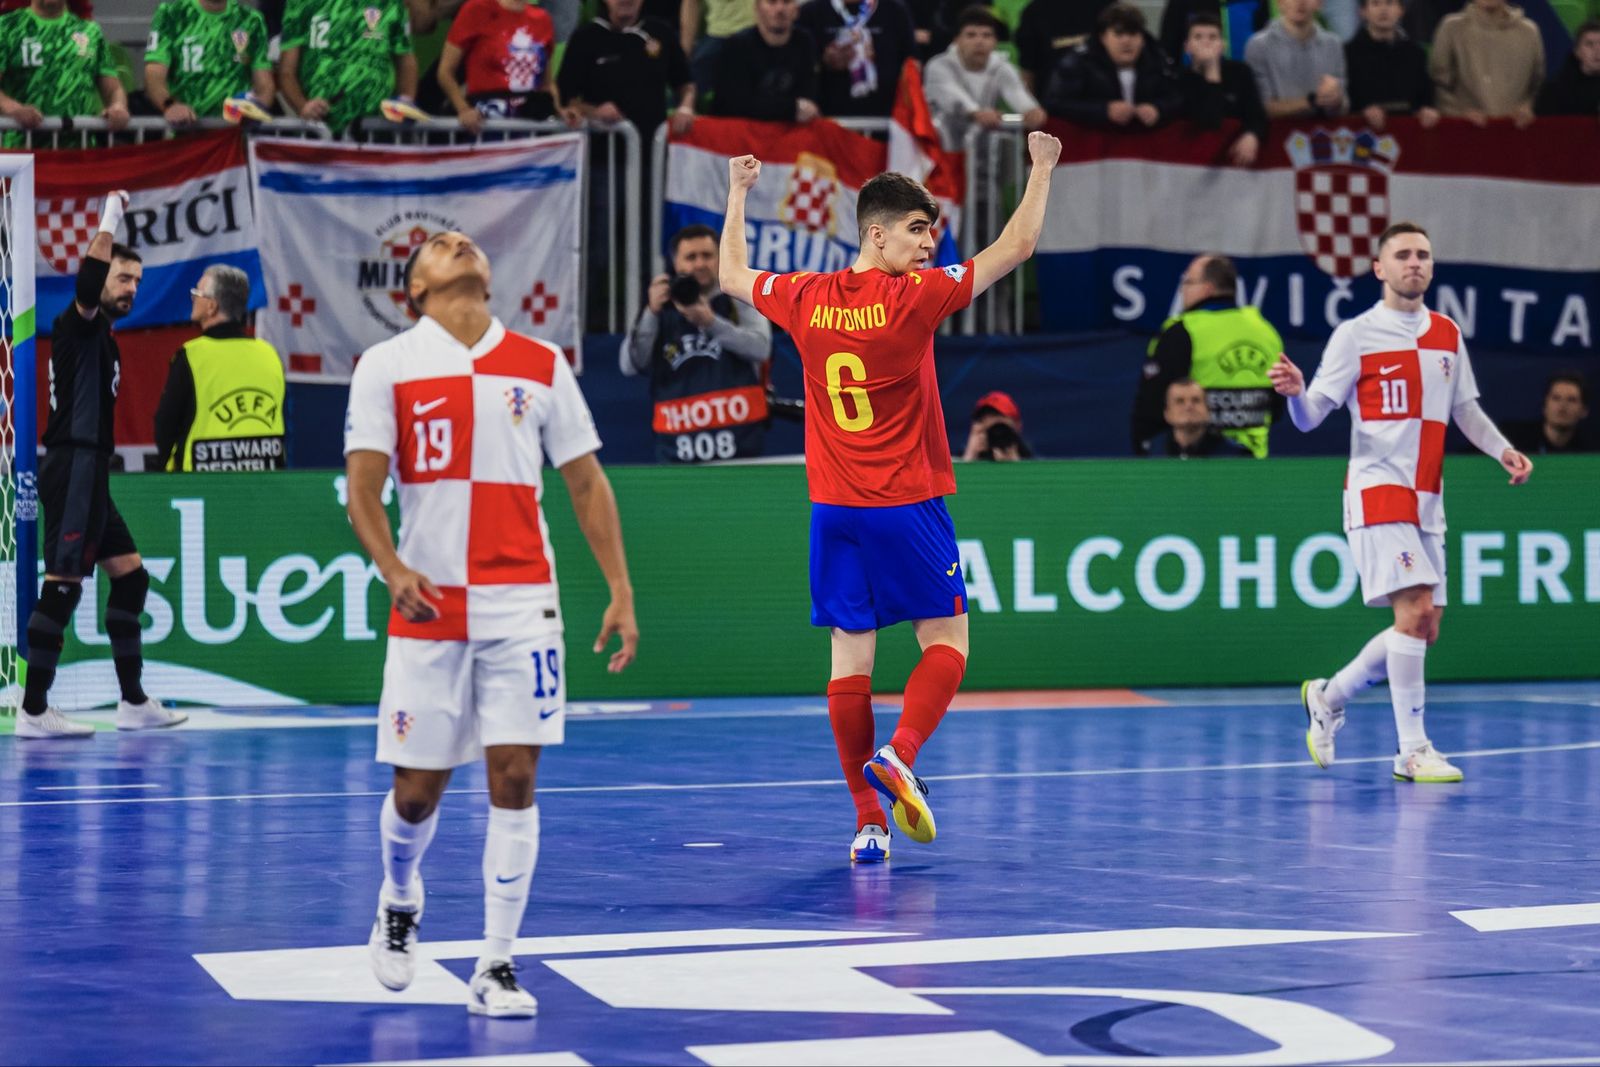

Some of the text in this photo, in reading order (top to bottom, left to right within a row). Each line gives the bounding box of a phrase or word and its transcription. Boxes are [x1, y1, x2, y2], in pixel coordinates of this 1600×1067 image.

[310, 20, 330, 49] 12
[21, 42, 44, 67] 12
[182, 44, 204, 72] 12
[745, 222, 860, 273] RUD
[809, 303, 887, 331] ANTONIO
[1112, 265, 1592, 347] SVIČNTA
[215, 394, 278, 423] UEFA
[825, 352, 874, 432] 6
[1379, 379, 1408, 414] 10
[195, 438, 282, 461] STEWARD
[412, 418, 452, 472] 19
[956, 532, 1359, 612] ALCOHO
[531, 648, 559, 698] 19
